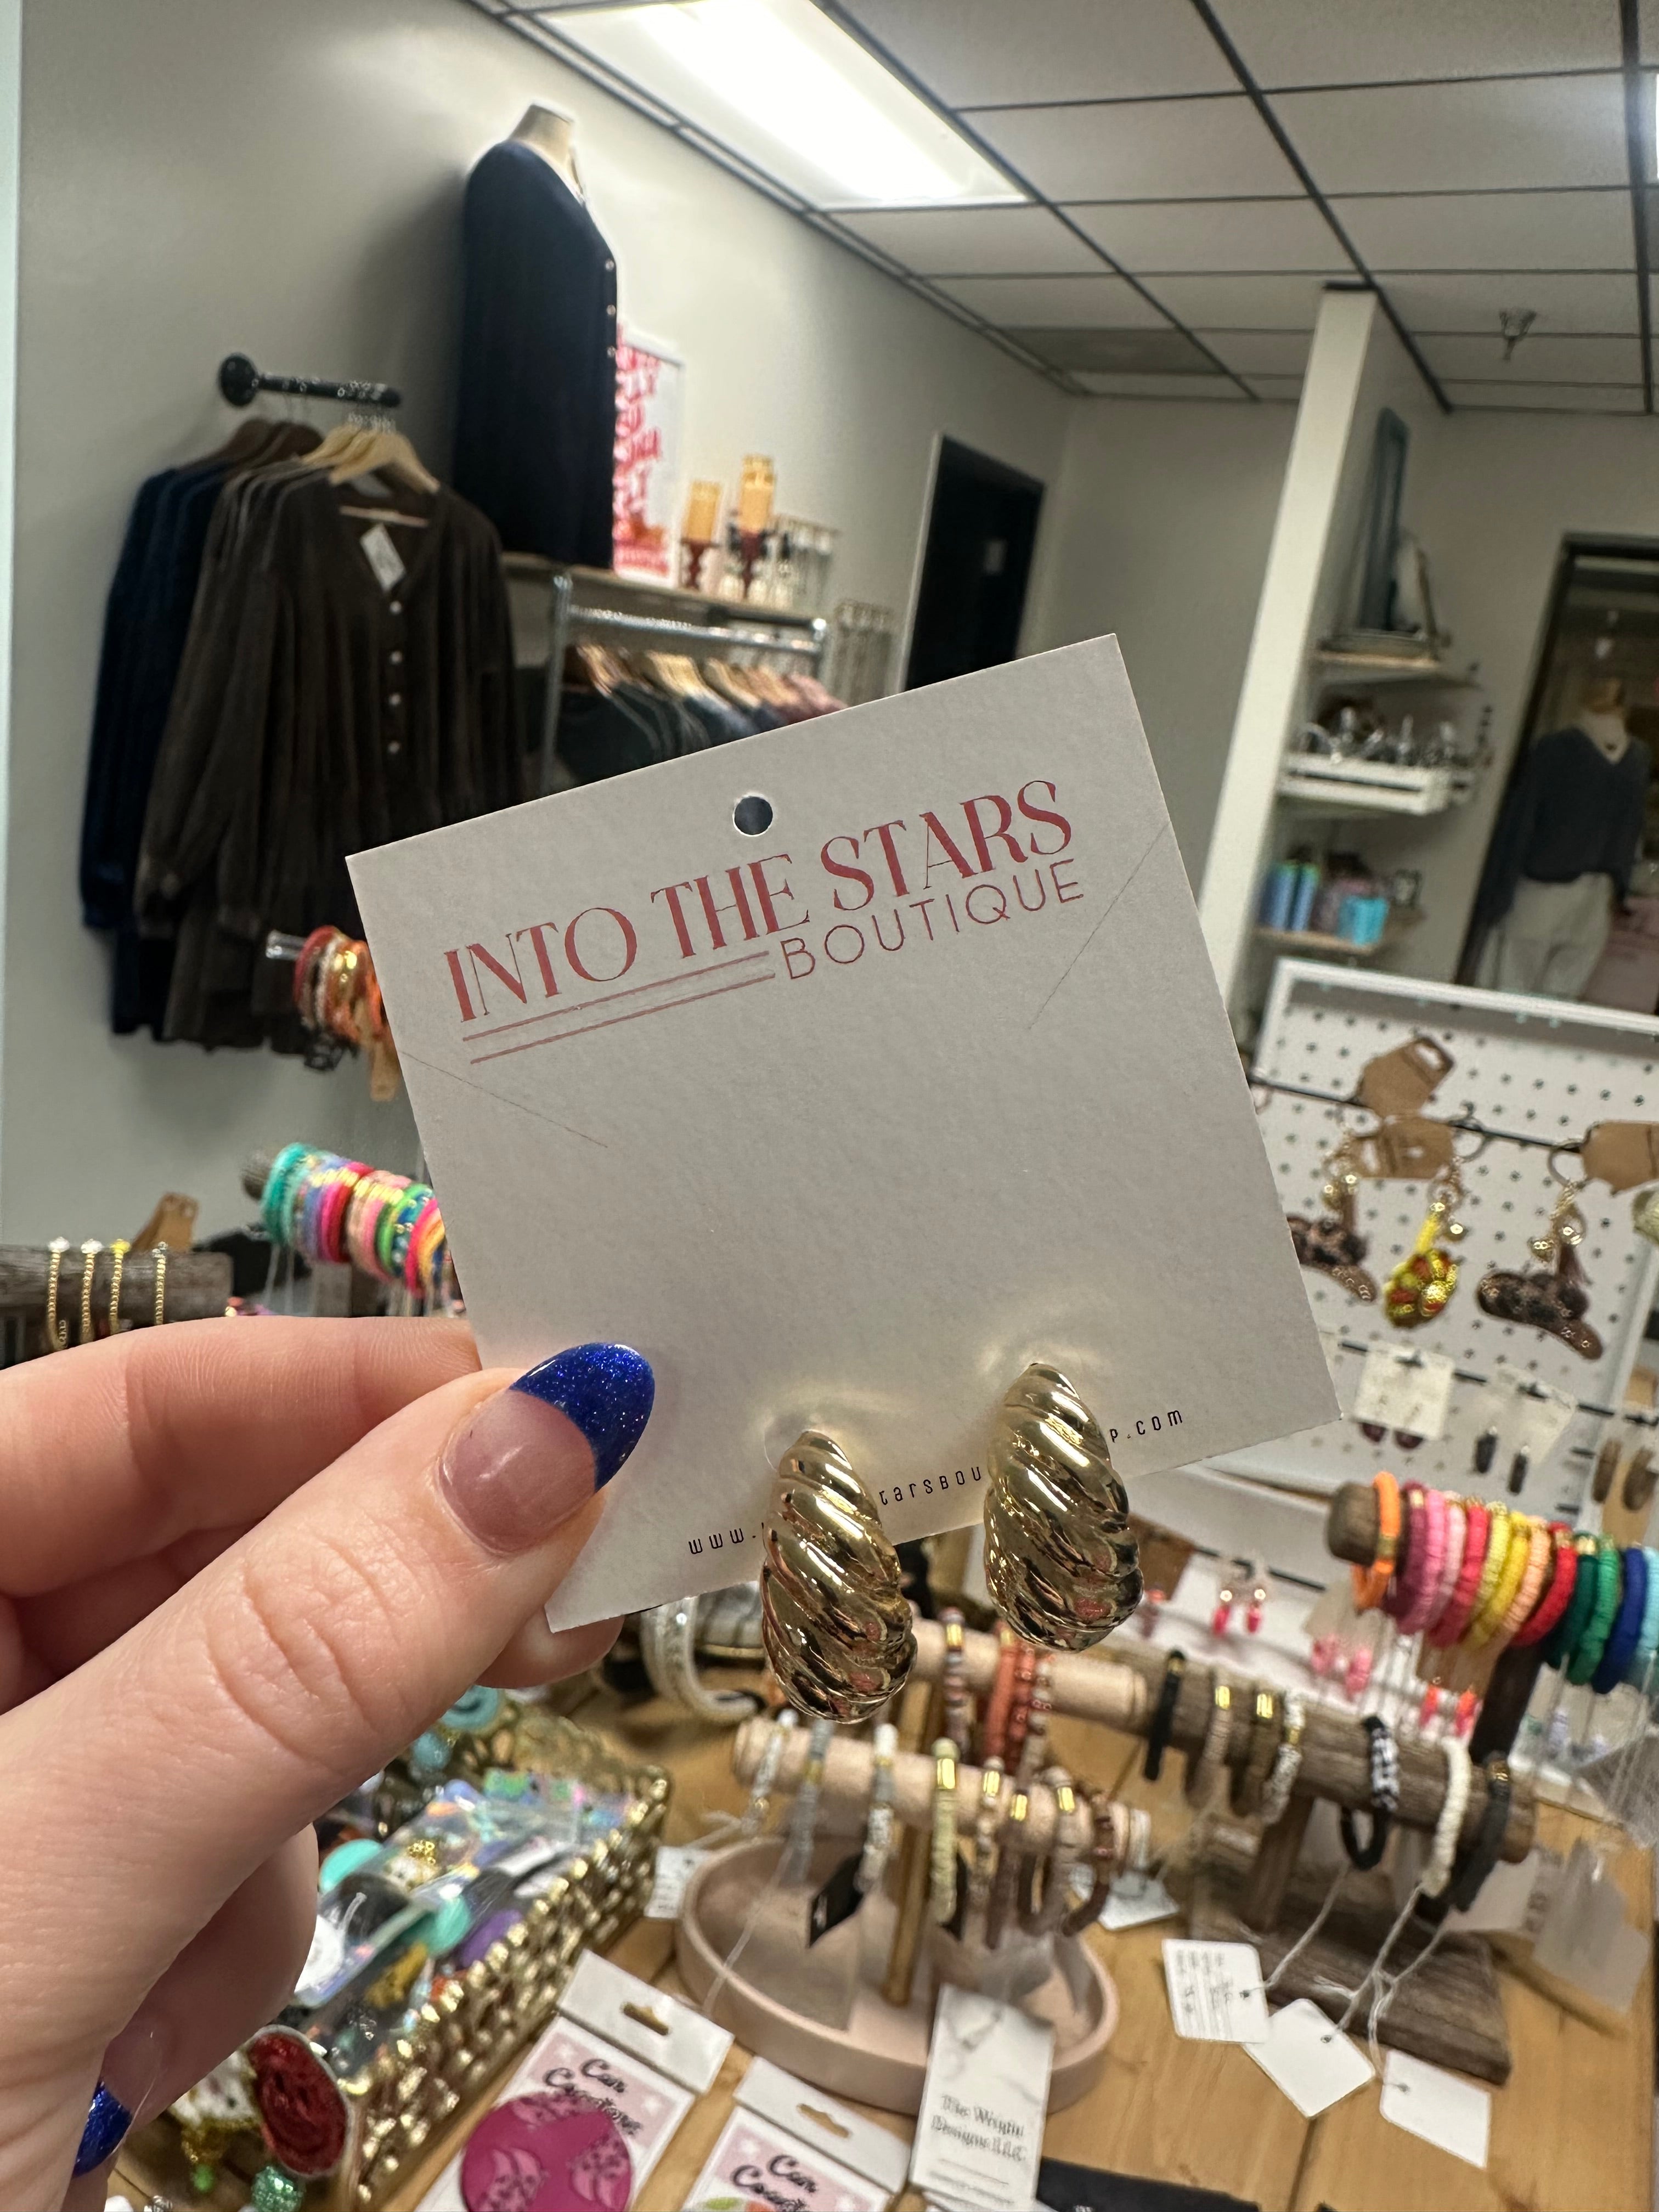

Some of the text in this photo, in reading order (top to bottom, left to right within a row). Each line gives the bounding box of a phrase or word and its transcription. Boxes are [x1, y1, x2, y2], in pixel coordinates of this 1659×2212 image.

[444, 779, 1074, 1023] INTO THE STARS
[780, 858, 1085, 980] BOUTIQUE
